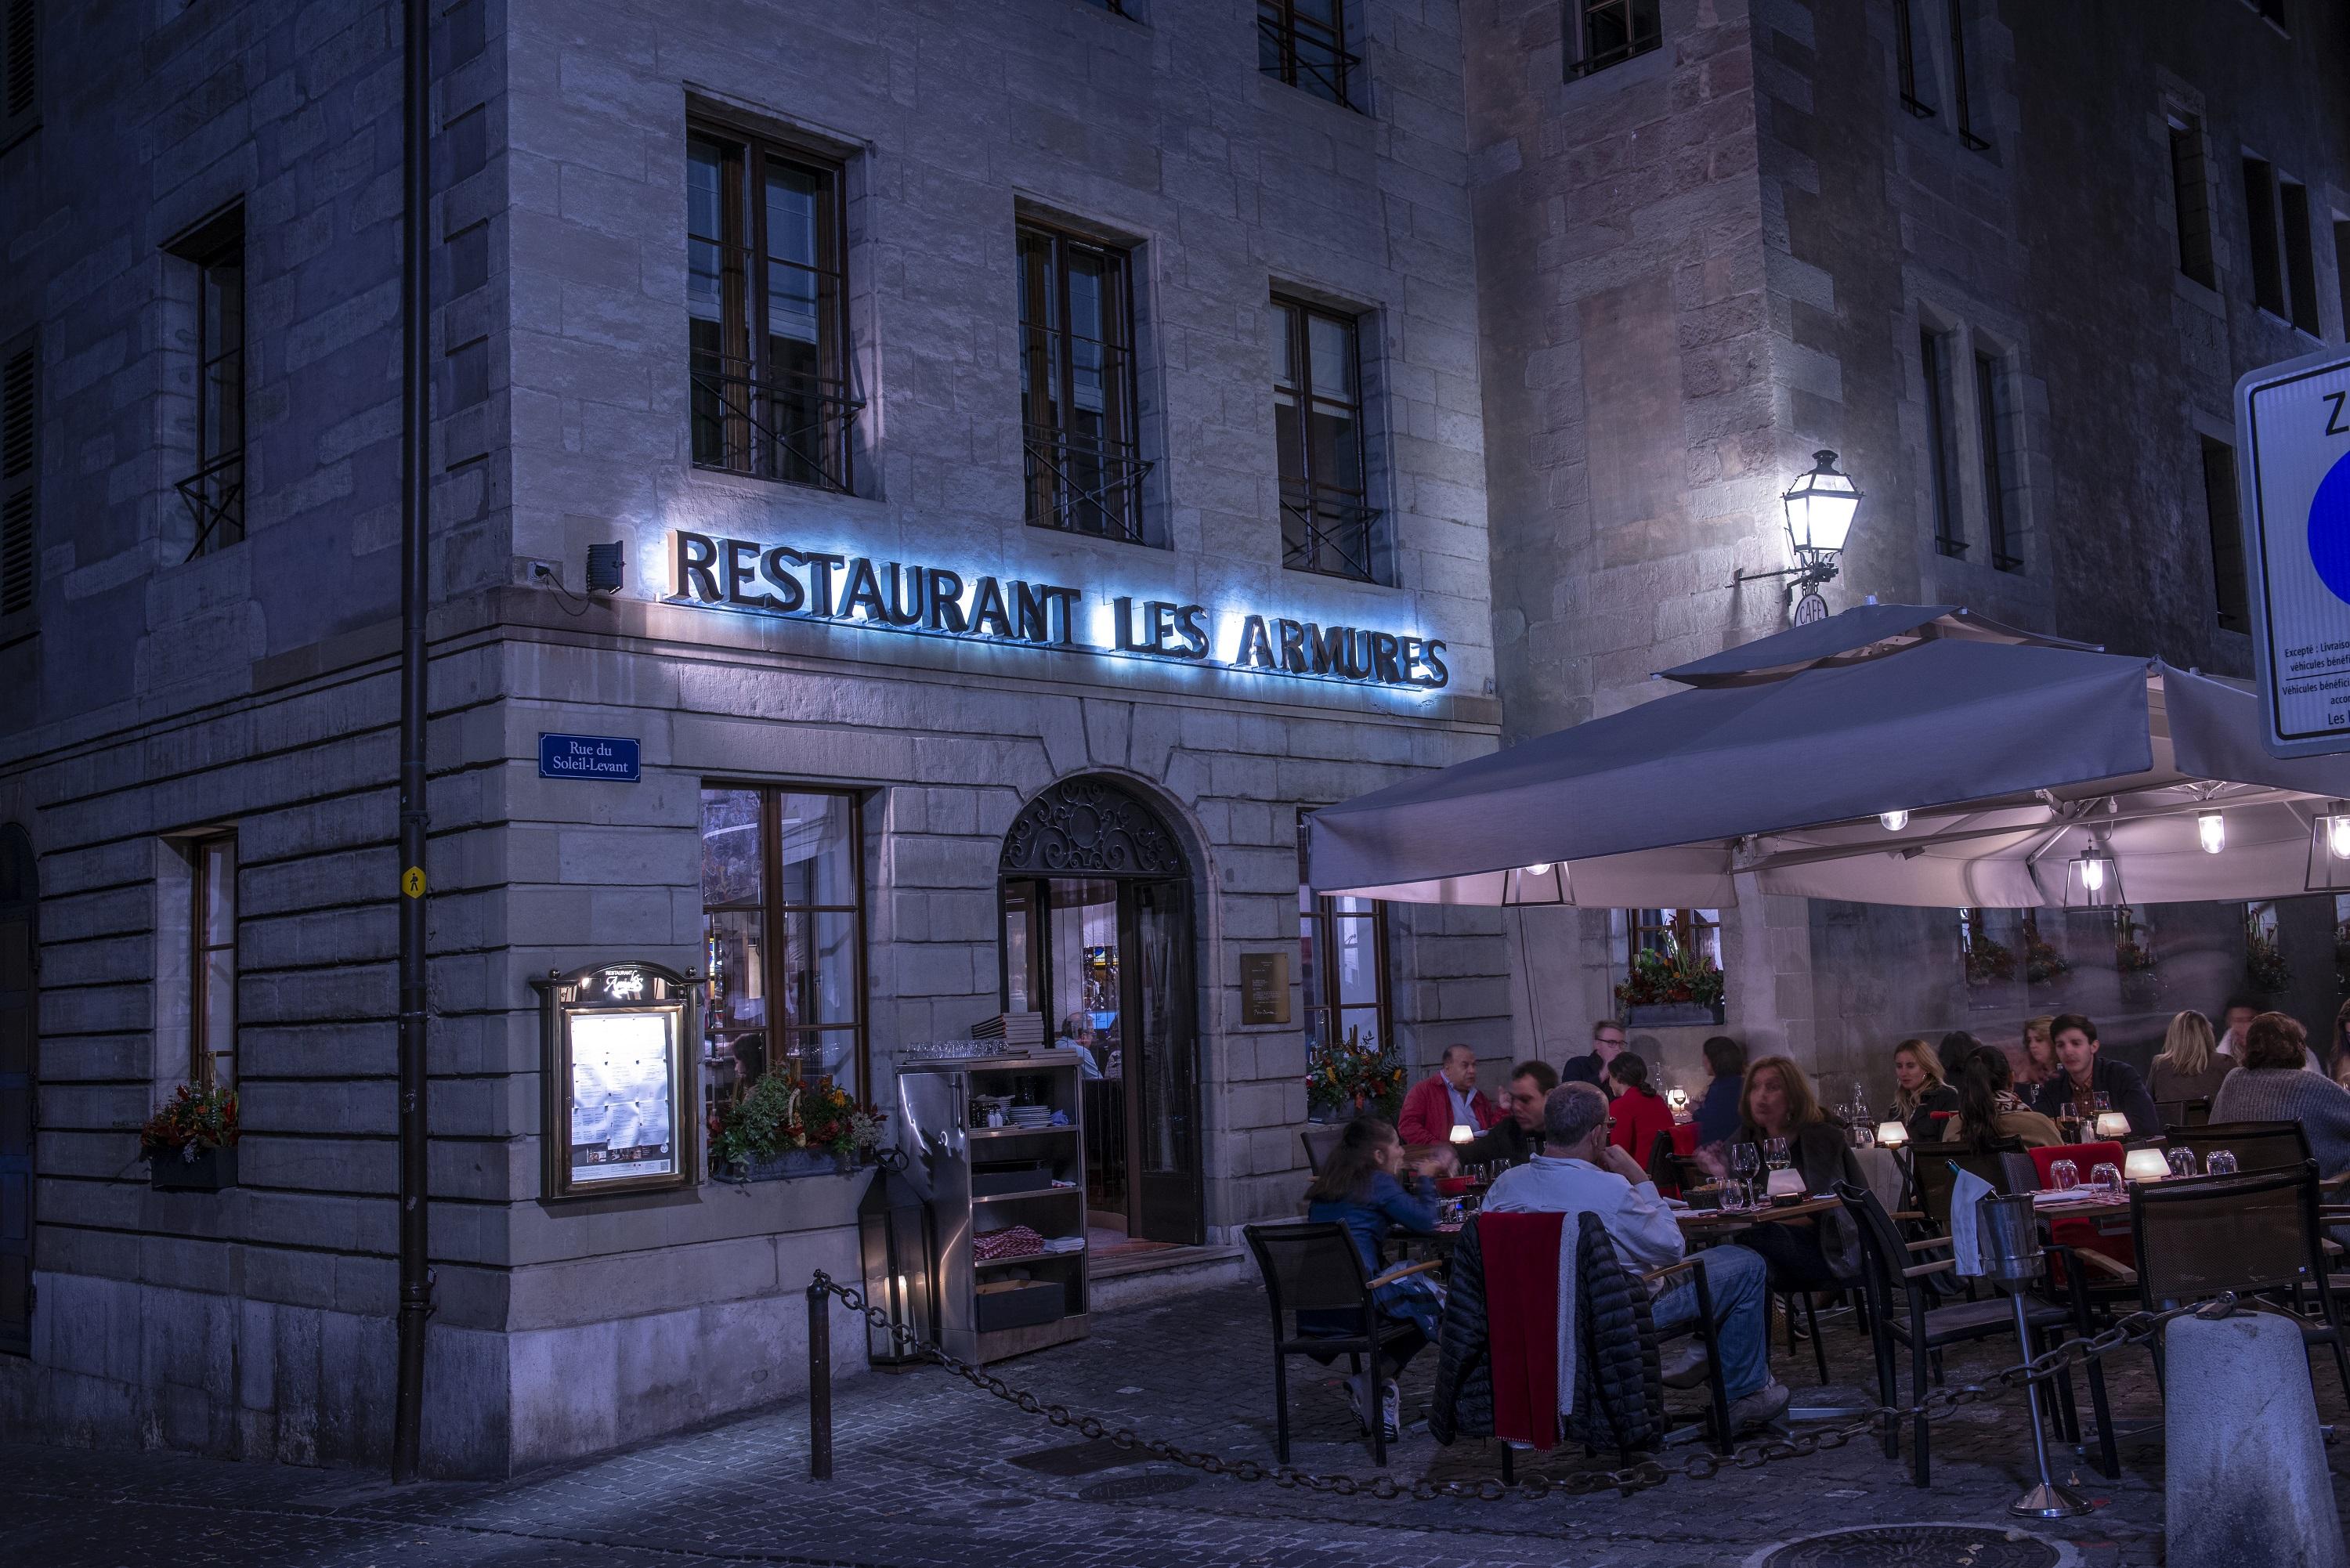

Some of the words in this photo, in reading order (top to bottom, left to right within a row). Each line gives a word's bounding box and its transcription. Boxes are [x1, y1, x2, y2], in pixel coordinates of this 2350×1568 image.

[2323, 391, 2349, 436] Z
[666, 529, 1082, 645] RESTAURANT
[1111, 595, 1210, 660] LES
[1231, 614, 1449, 689] ARMURES
[2285, 645, 2314, 658] Excepté
[2290, 659, 2325, 672] véhicules
[2282, 683, 2318, 695] Véhicules
[2319, 677, 2350, 690] bénéfici
[2327, 713, 2345, 725] Les
[569, 741, 594, 755] Rue
[596, 742, 613, 757] du
[553, 756, 628, 772] Soleil-Levant
